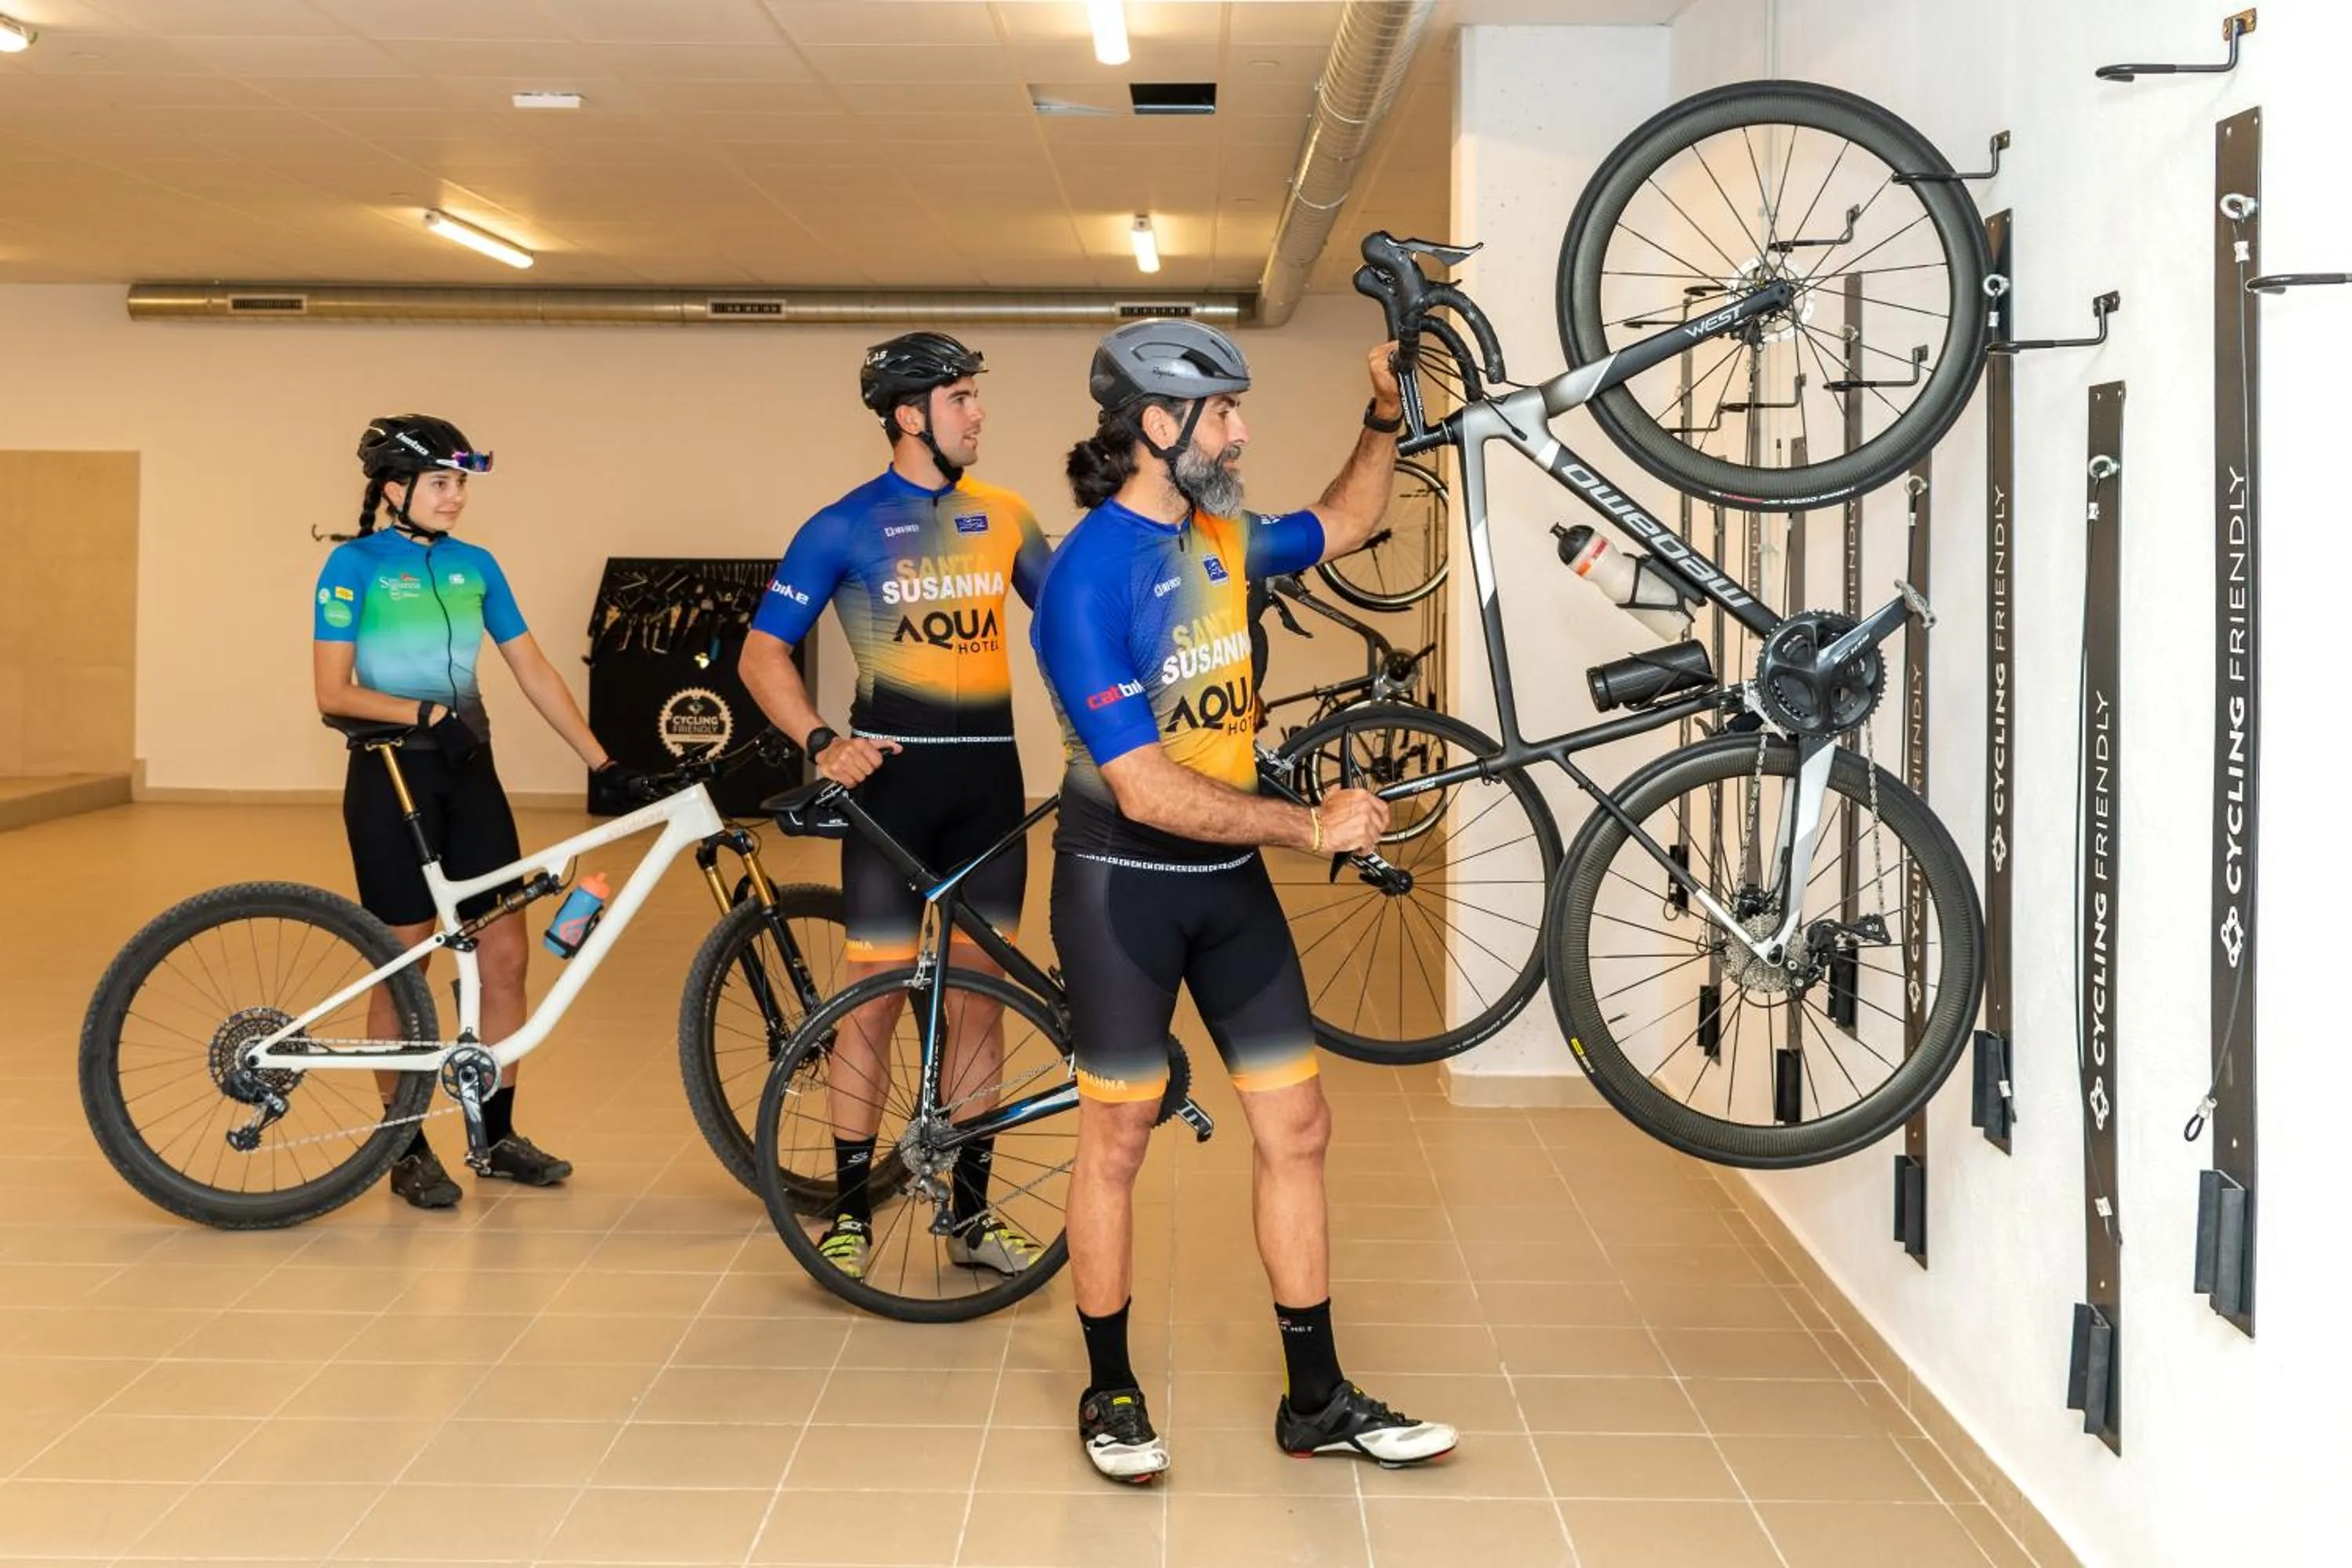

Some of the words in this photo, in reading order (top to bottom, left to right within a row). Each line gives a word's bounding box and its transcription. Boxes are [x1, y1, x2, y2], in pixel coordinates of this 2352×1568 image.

[1685, 303, 1744, 338] WEST
[882, 572, 1004, 604] SUSANNA
[1994, 485, 2005, 651] FRIENDLY
[2229, 465, 2245, 682] FRIENDLY
[893, 608, 999, 650] AQUA
[958, 640, 999, 654] HOTEL
[1161, 628, 1253, 685] SUSANN
[673, 716, 719, 725] CYCLING
[1913, 664, 1922, 795] RIENDLY
[1994, 662, 2006, 817] CYCLING
[2095, 690, 2109, 880] FRIENDLY
[2226, 695, 2245, 895] CYCLING
[1911, 860, 1922, 963] CYCLI
[2092, 891, 2107, 1067] CYCLING
